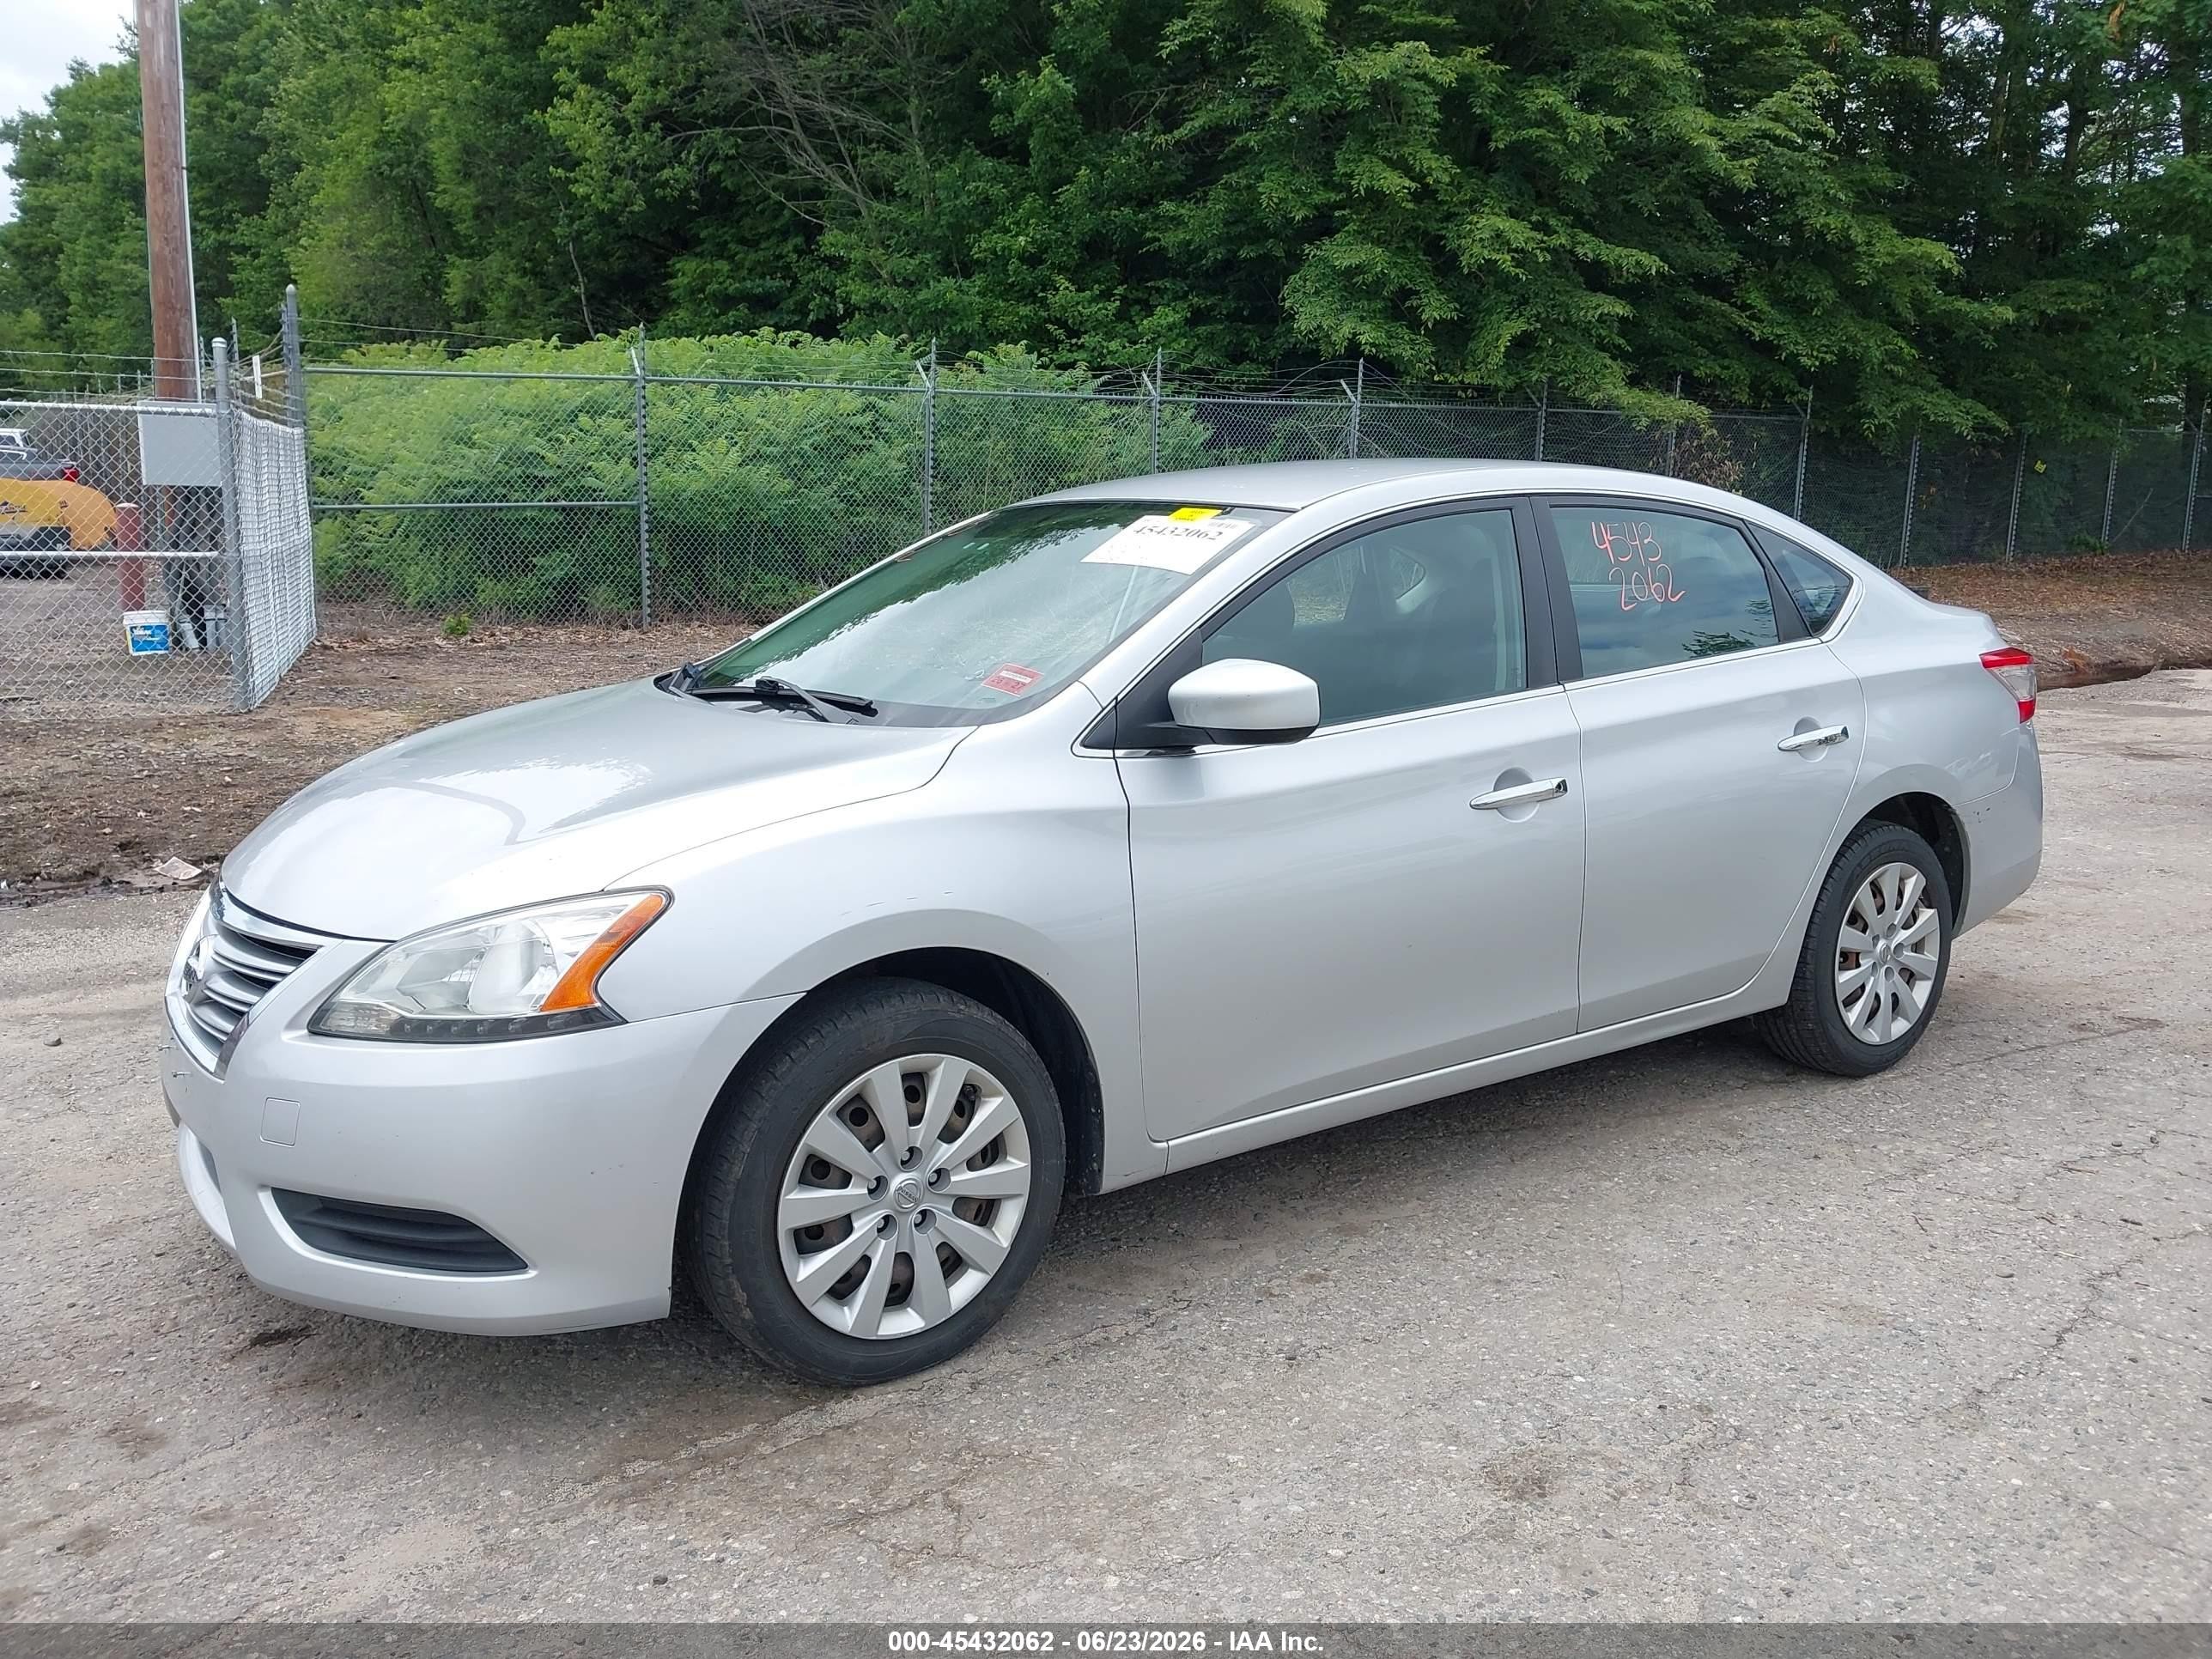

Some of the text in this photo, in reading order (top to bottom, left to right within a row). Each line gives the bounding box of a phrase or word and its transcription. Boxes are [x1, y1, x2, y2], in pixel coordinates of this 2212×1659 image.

[1133, 525, 1224, 541] 45432062
[1591, 521, 1662, 567] 4543
[1608, 563, 1686, 611] 2062
[898, 1186, 919, 1202] NISSAN
